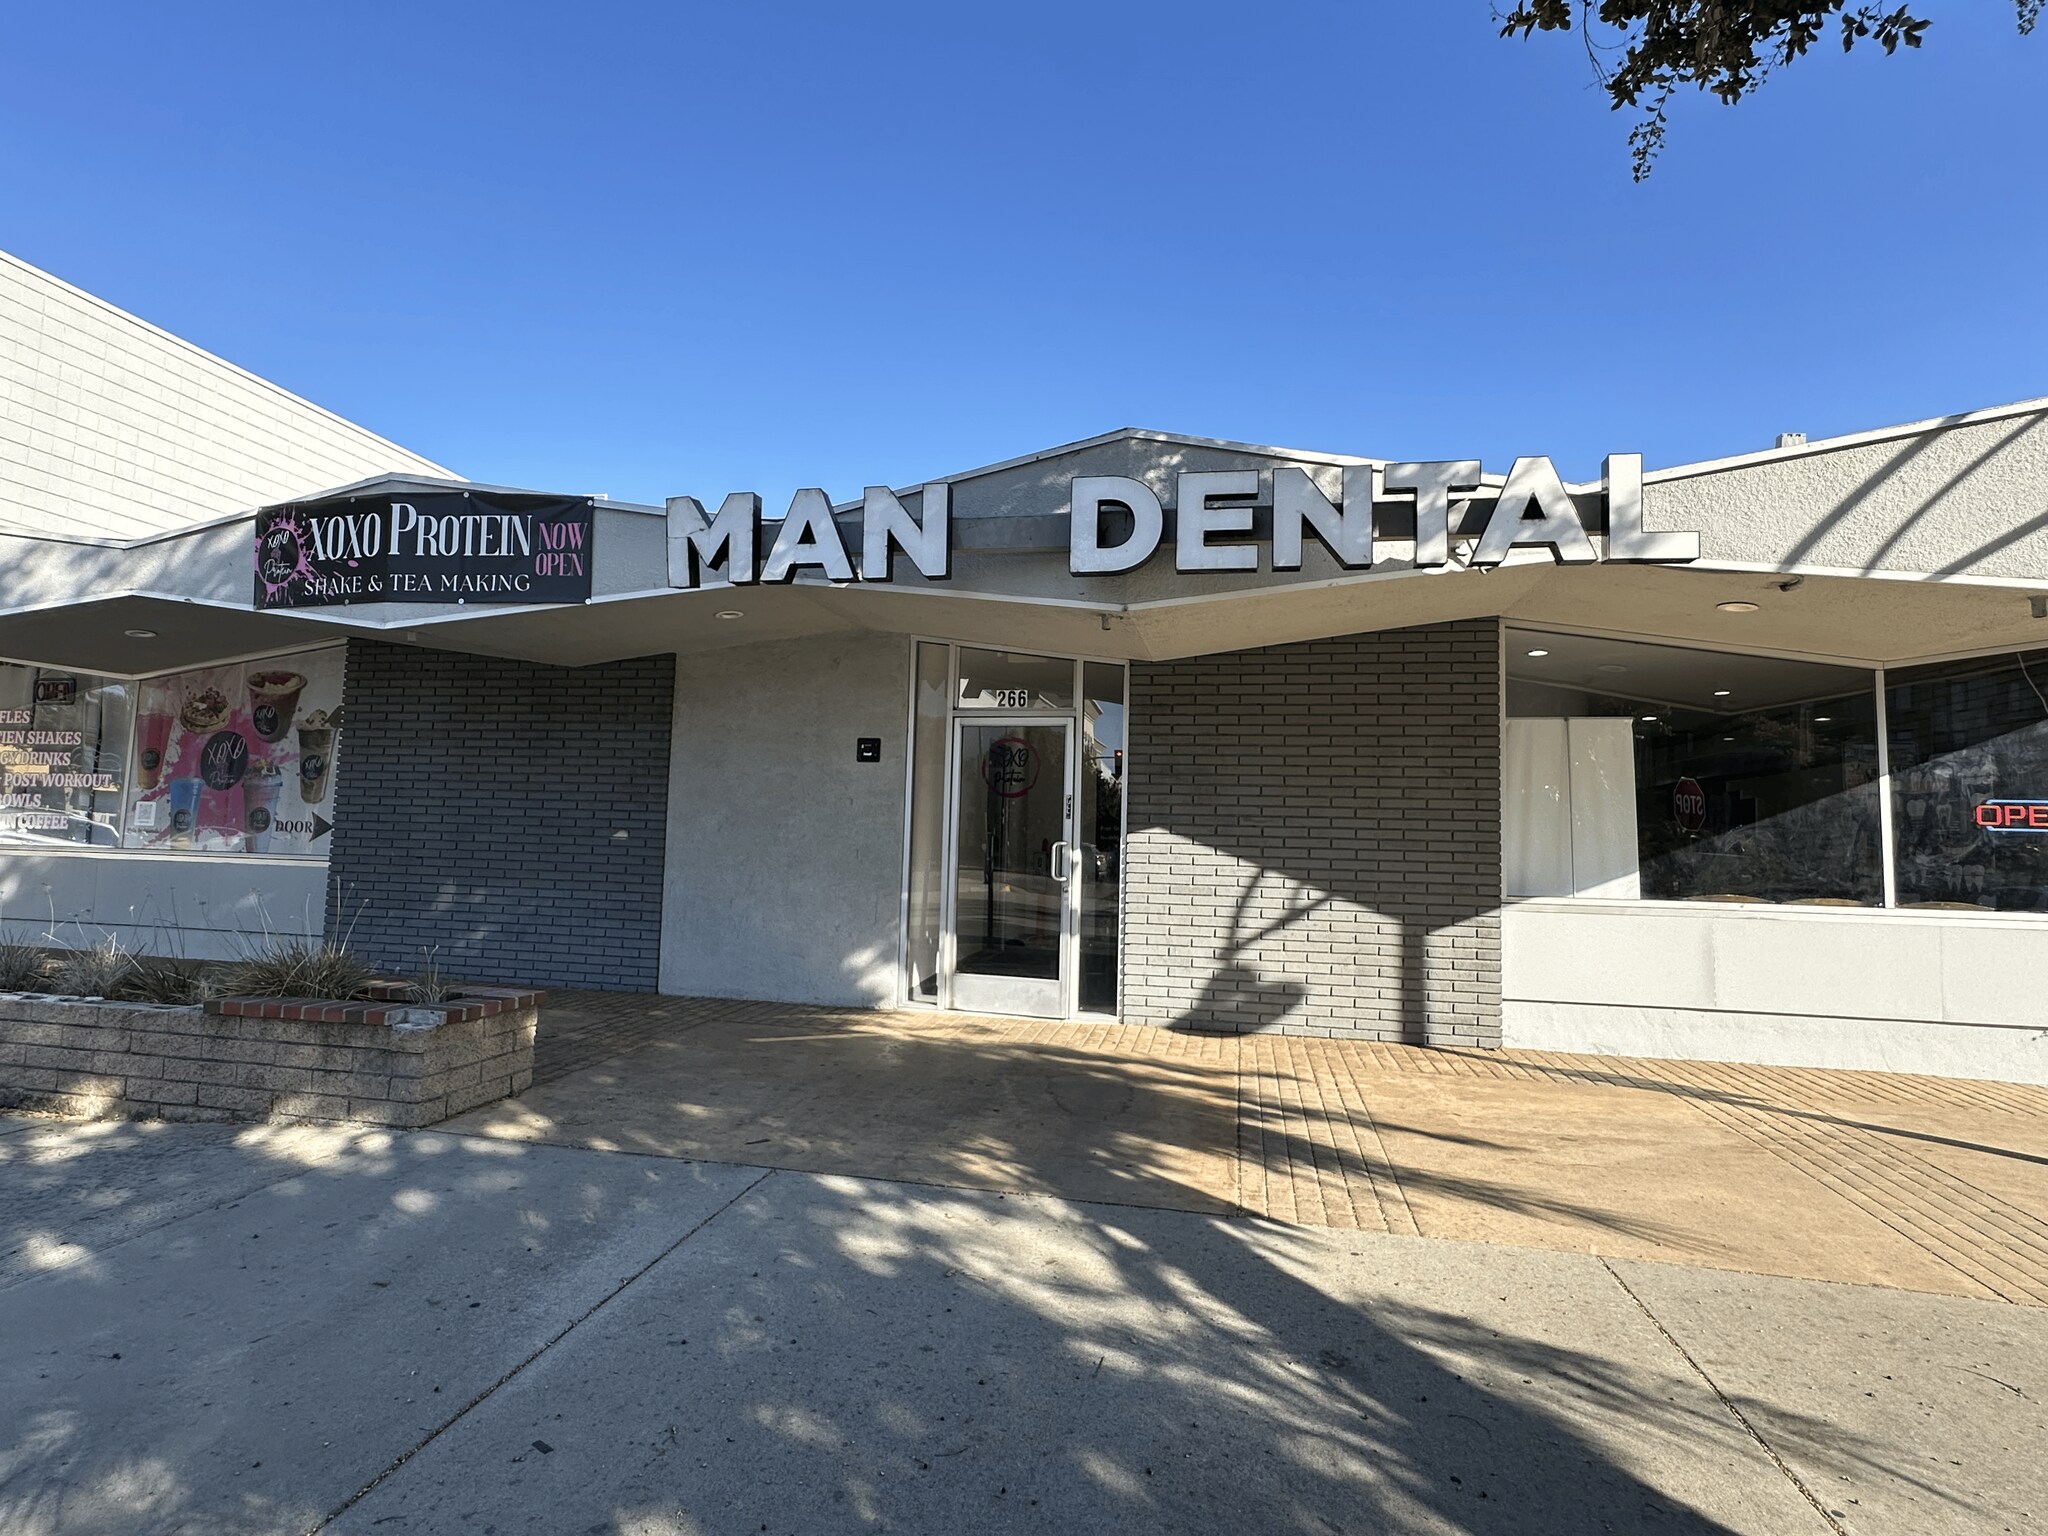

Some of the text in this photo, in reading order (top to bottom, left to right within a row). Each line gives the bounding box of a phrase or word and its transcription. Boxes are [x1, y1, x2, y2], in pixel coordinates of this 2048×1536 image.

[666, 453, 1701, 588] MAN DENTAL
[267, 530, 290, 549] XOXO
[308, 503, 532, 562] XOXO PROTEIN
[538, 522, 588, 551] NOW
[535, 553, 584, 576] OPEN
[304, 574, 530, 596] SHAKE & TEA MAKING
[998, 690, 1027, 707] 266
[27, 731, 82, 745] SHAKES
[20, 752, 71, 766] DRINKS
[208, 735, 246, 766] XOXO
[4, 772, 112, 788] POST WORKOUT
[0, 793, 41, 807] OWLS
[17, 814, 69, 829] COFFEE
[275, 821, 313, 833] DOOR
